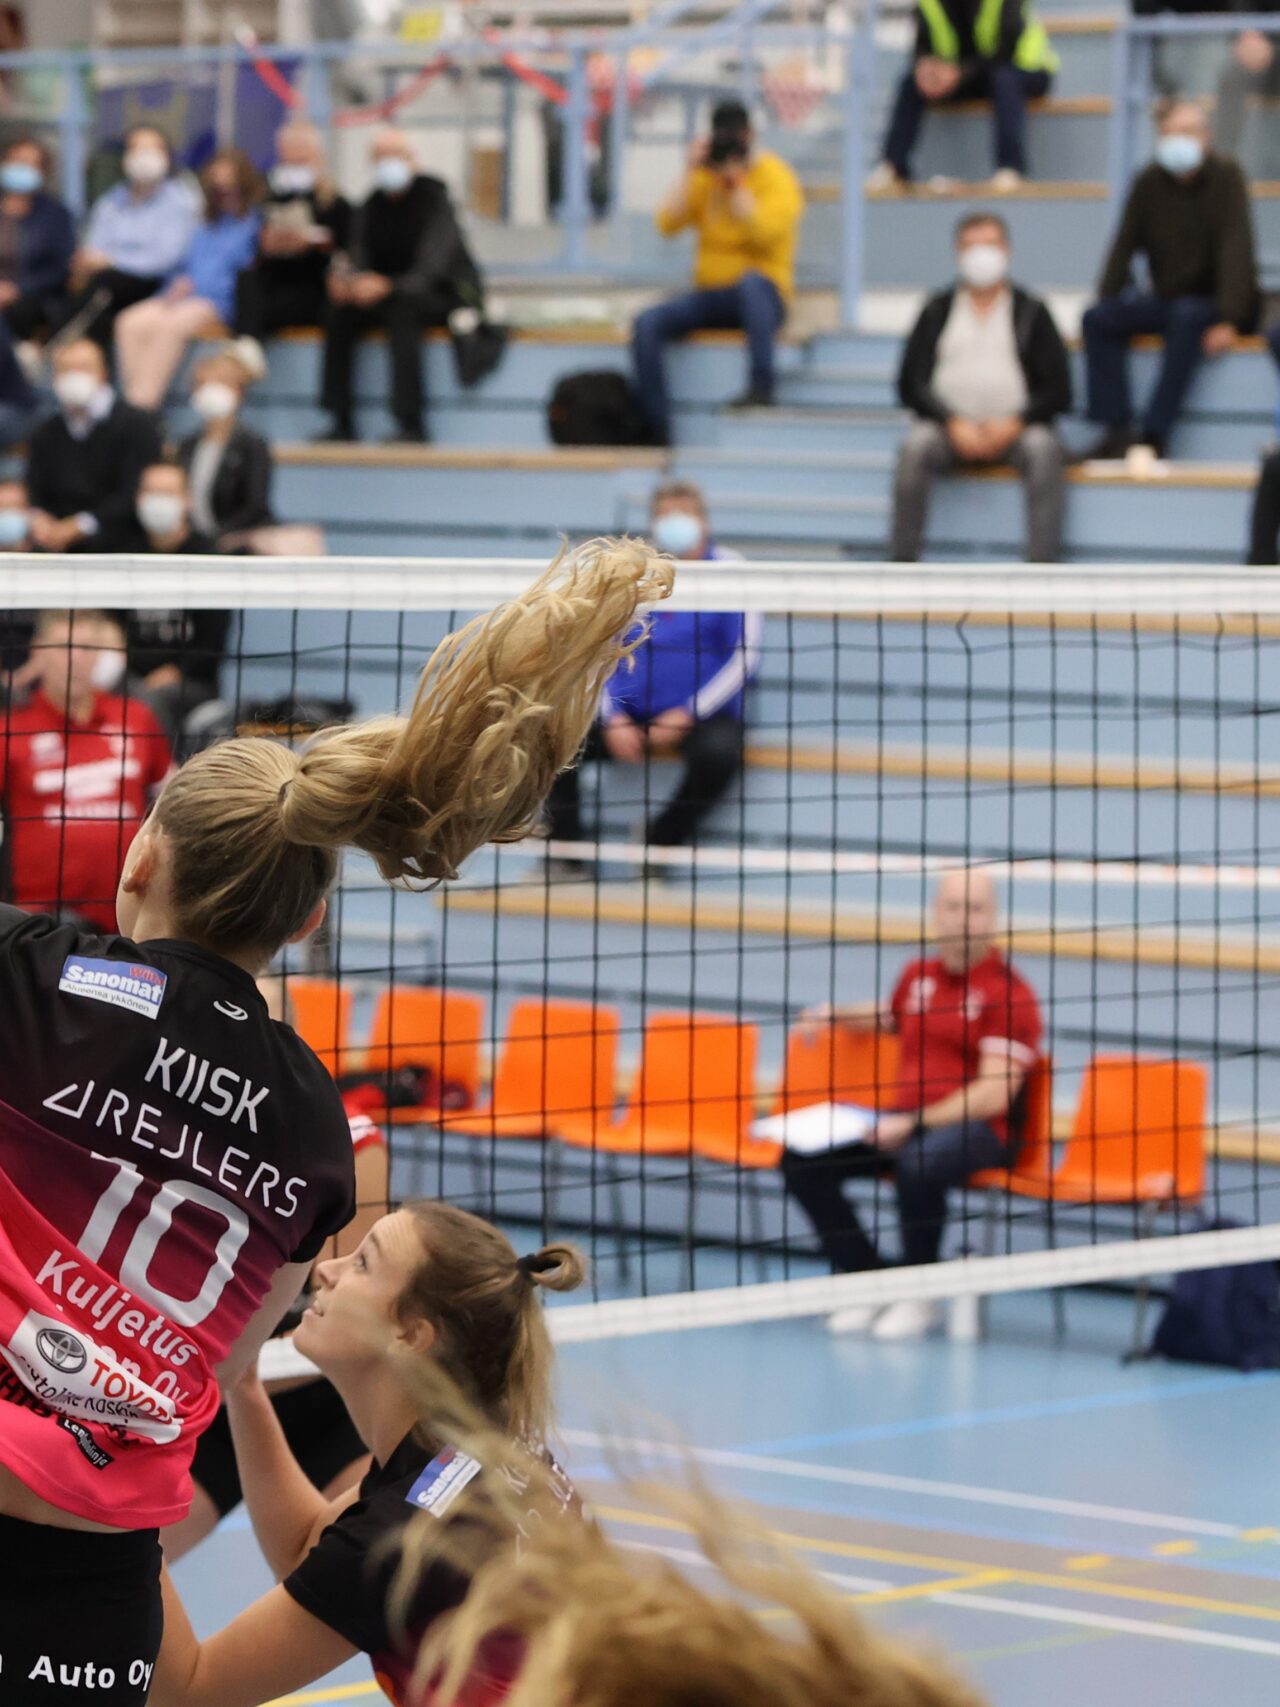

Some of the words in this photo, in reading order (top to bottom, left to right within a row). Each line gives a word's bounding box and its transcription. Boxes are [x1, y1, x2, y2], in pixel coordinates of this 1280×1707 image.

[65, 964, 162, 1003] Sanomat
[144, 1037, 270, 1133] KIISK
[95, 1088, 308, 1218] REJLERS
[76, 1150, 250, 1328] 10
[35, 1249, 199, 1366] Kuljetus
[28, 1655, 116, 1689] Auto
[128, 1659, 153, 1692] Oy
